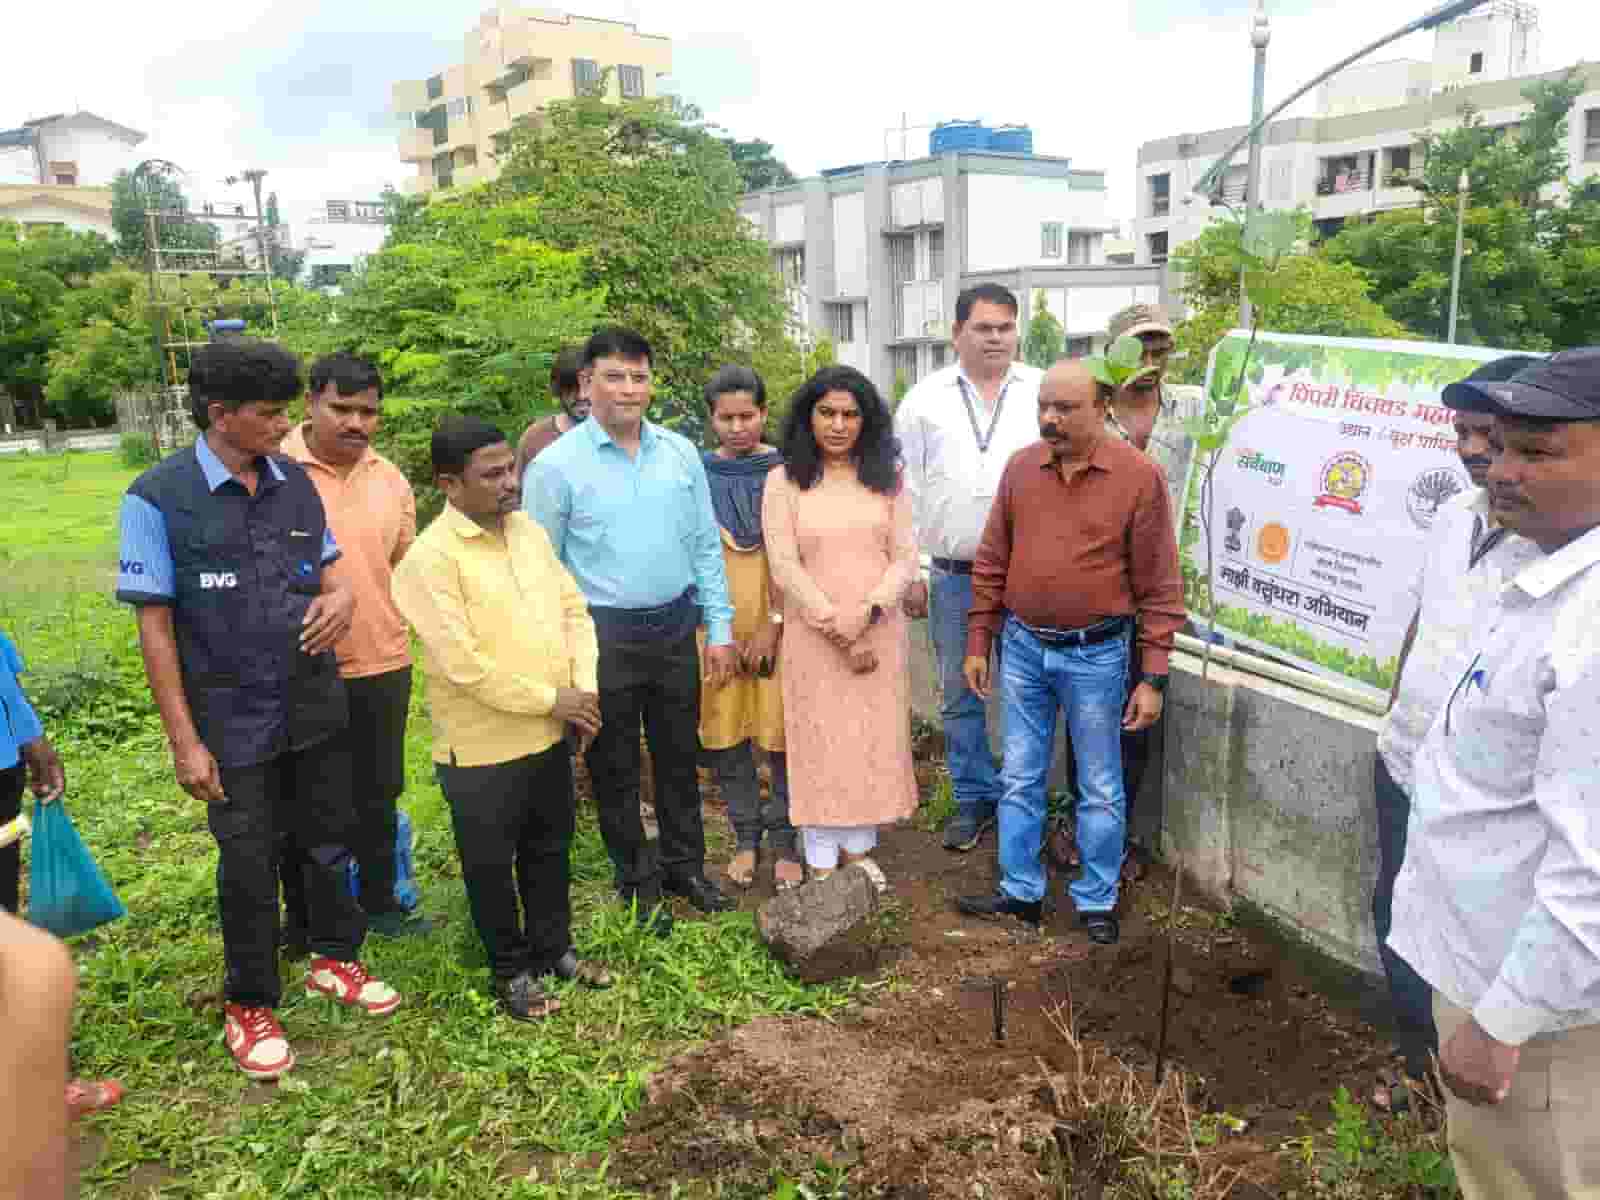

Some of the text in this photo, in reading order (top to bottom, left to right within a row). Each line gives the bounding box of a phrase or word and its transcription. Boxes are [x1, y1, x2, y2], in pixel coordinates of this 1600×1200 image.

[1289, 384, 1338, 408] पिंपरी
[119, 560, 144, 575] VG
[200, 572, 238, 589] BVG
[1220, 566, 1249, 590] माझी
[1252, 577, 1300, 608] वसुंधरा
[1304, 595, 1371, 631] अभियान
